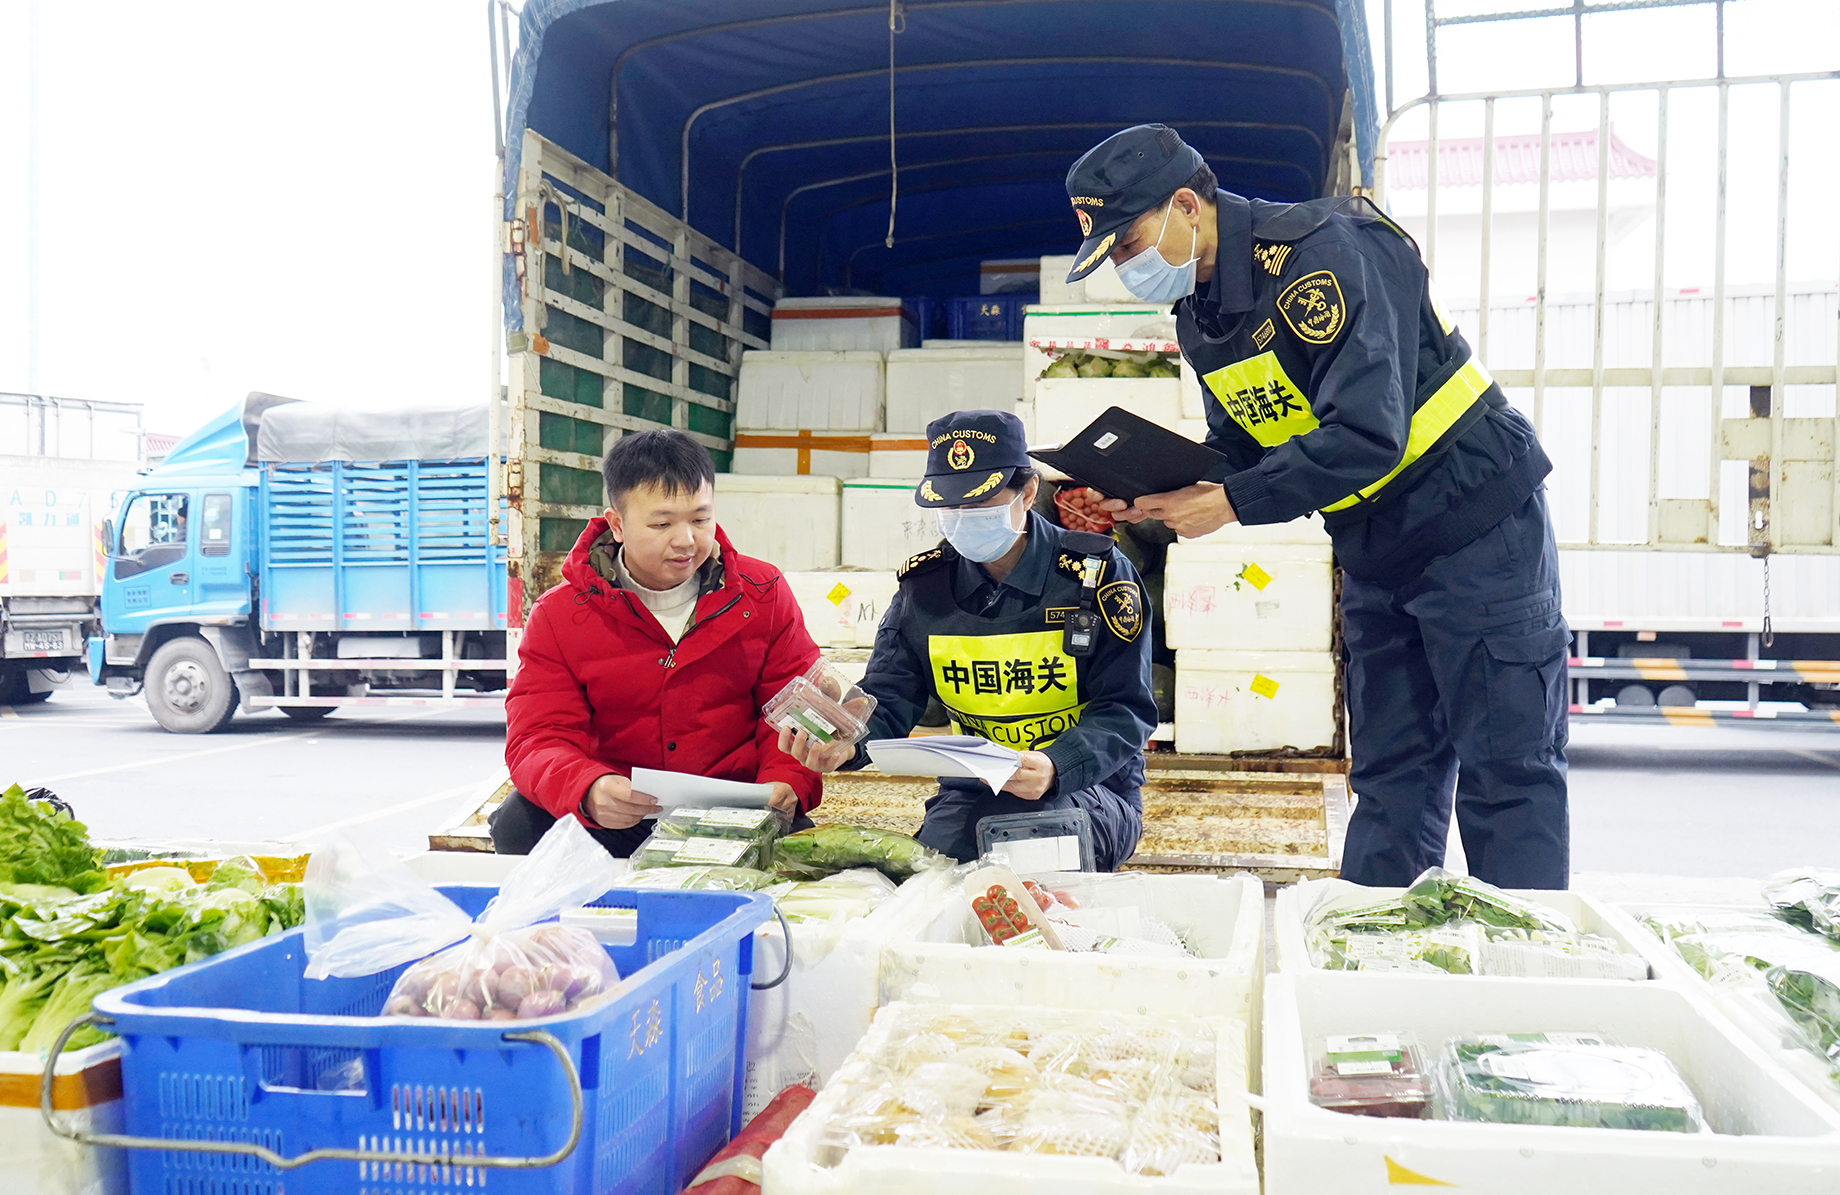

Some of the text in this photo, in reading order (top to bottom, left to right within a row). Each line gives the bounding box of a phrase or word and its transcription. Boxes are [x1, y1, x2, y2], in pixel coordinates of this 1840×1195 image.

[1284, 278, 1332, 310] CHINA CUSTOMS
[1226, 380, 1303, 428] 中国海关
[931, 429, 997, 449] CHINA CUSTOMS
[1101, 587, 1117, 602] CHINA
[1050, 611, 1065, 619] 574
[942, 656, 1067, 695] 中国海关
[992, 709, 1085, 744] CUSTOM
[693, 958, 723, 1014] 食品
